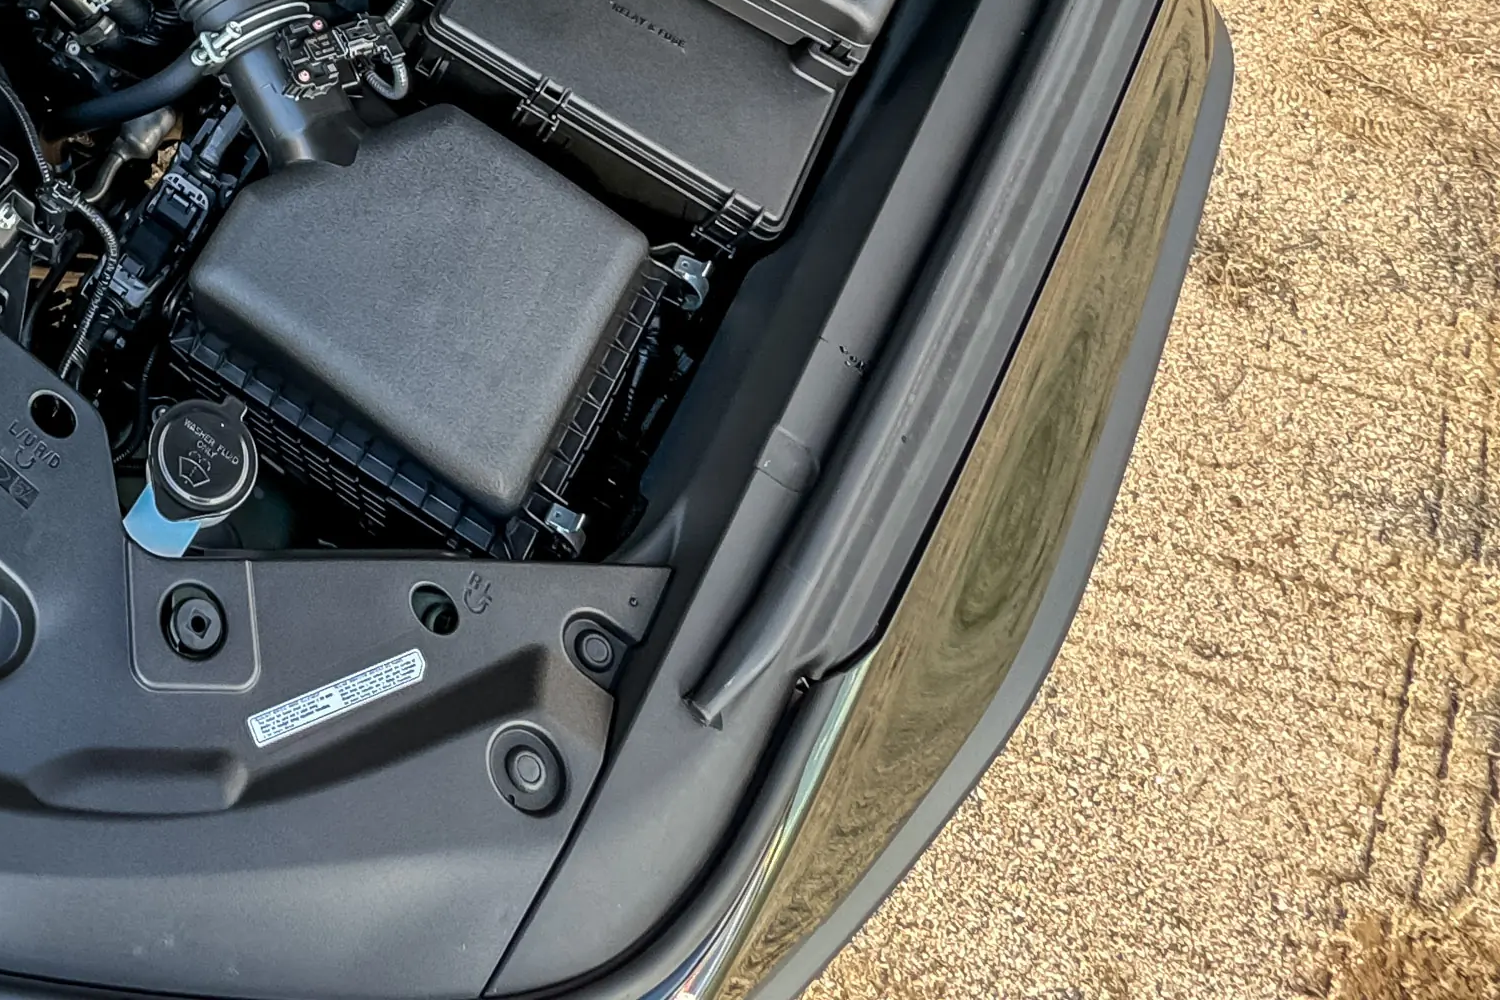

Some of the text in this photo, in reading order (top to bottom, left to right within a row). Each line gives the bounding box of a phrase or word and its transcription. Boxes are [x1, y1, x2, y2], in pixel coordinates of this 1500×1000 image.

[610, 2, 647, 26] RELAY
[184, 418, 239, 465] WASHER FLUID
[196, 440, 218, 459] ONLY
